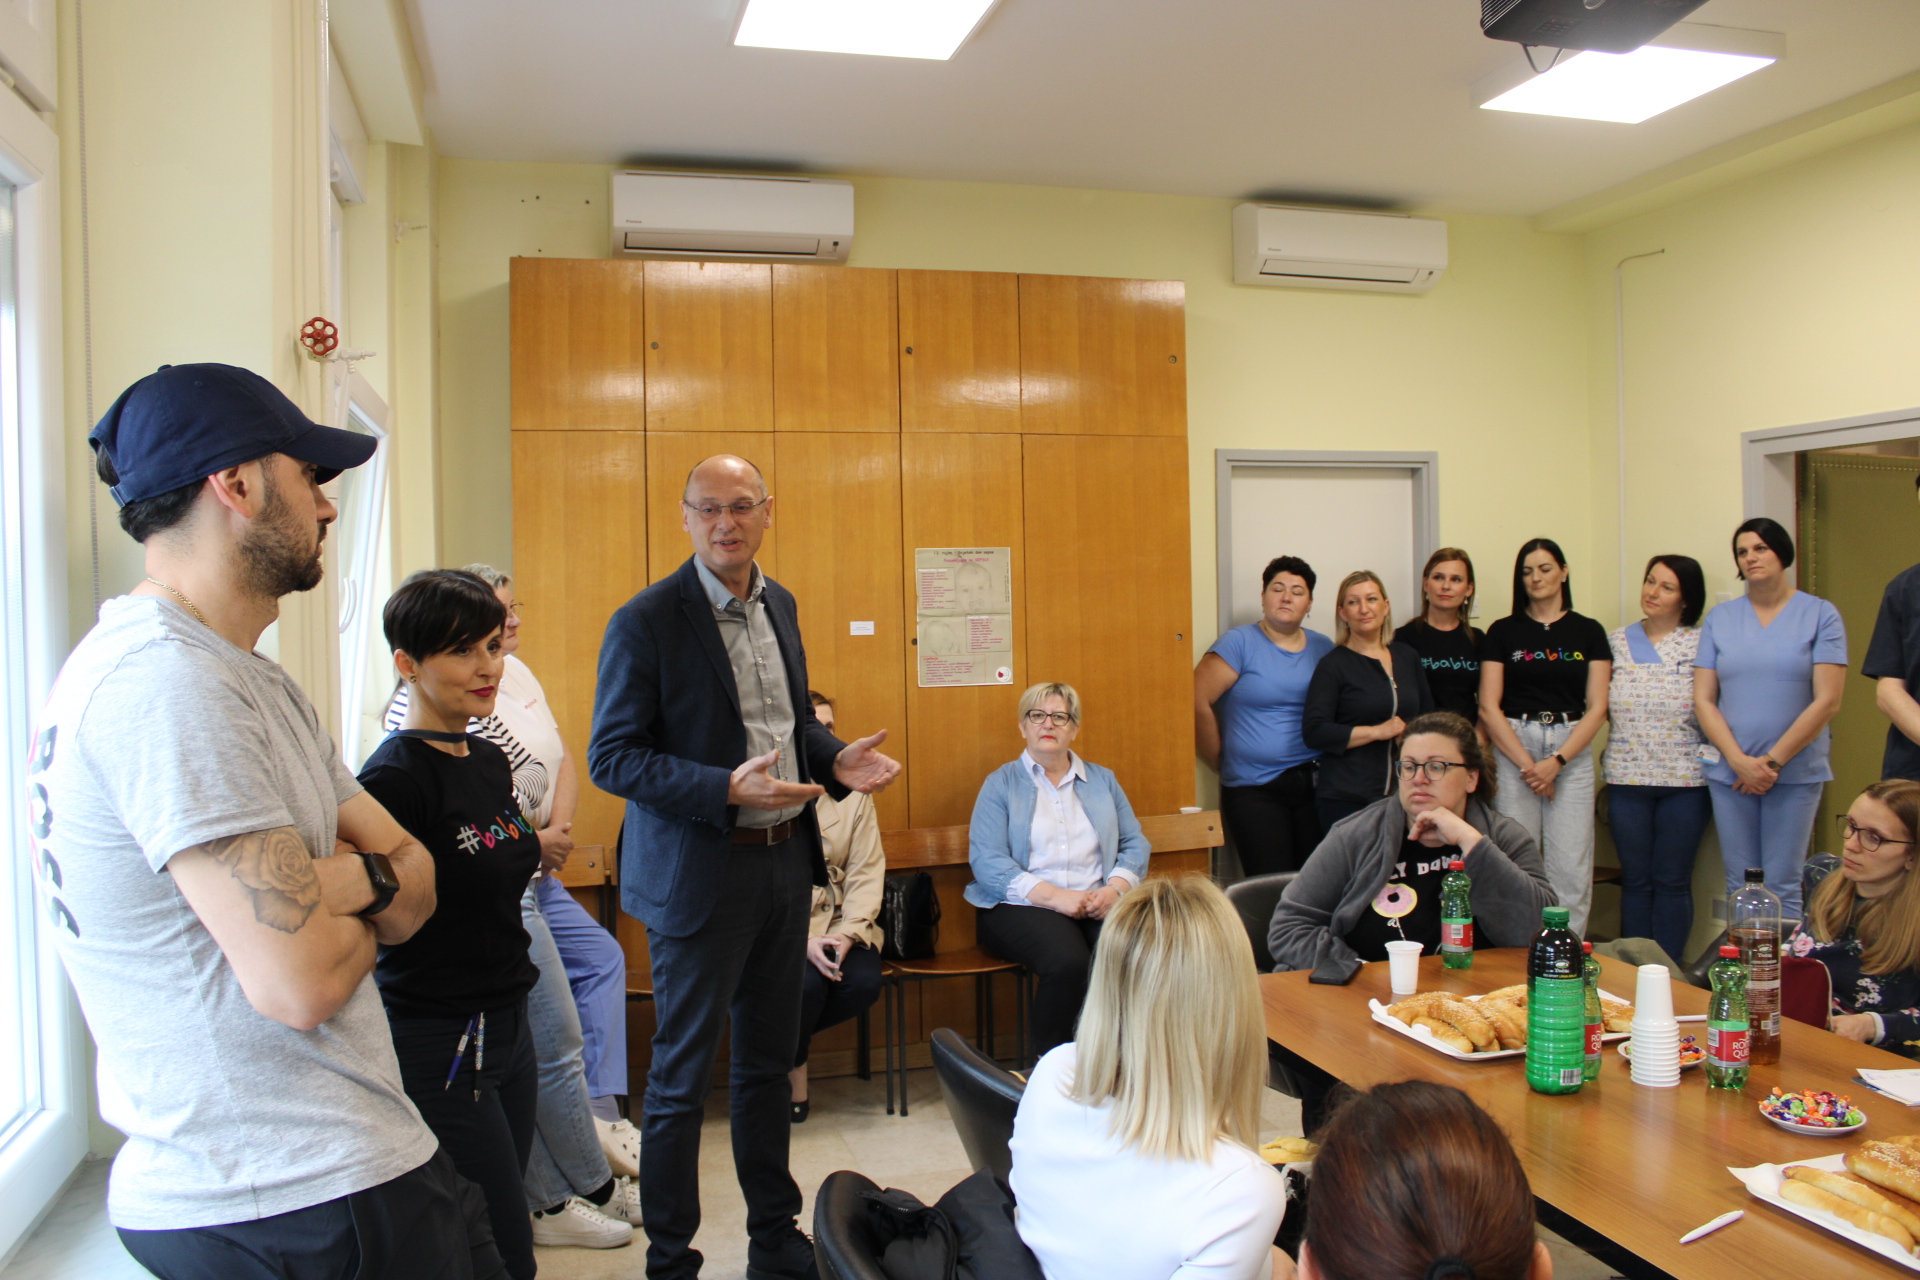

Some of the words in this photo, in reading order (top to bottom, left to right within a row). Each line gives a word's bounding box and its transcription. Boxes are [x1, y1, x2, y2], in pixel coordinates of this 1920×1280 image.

[1511, 647, 1585, 662] #babica
[456, 810, 534, 855] #babic
[1389, 861, 1407, 880] Y
